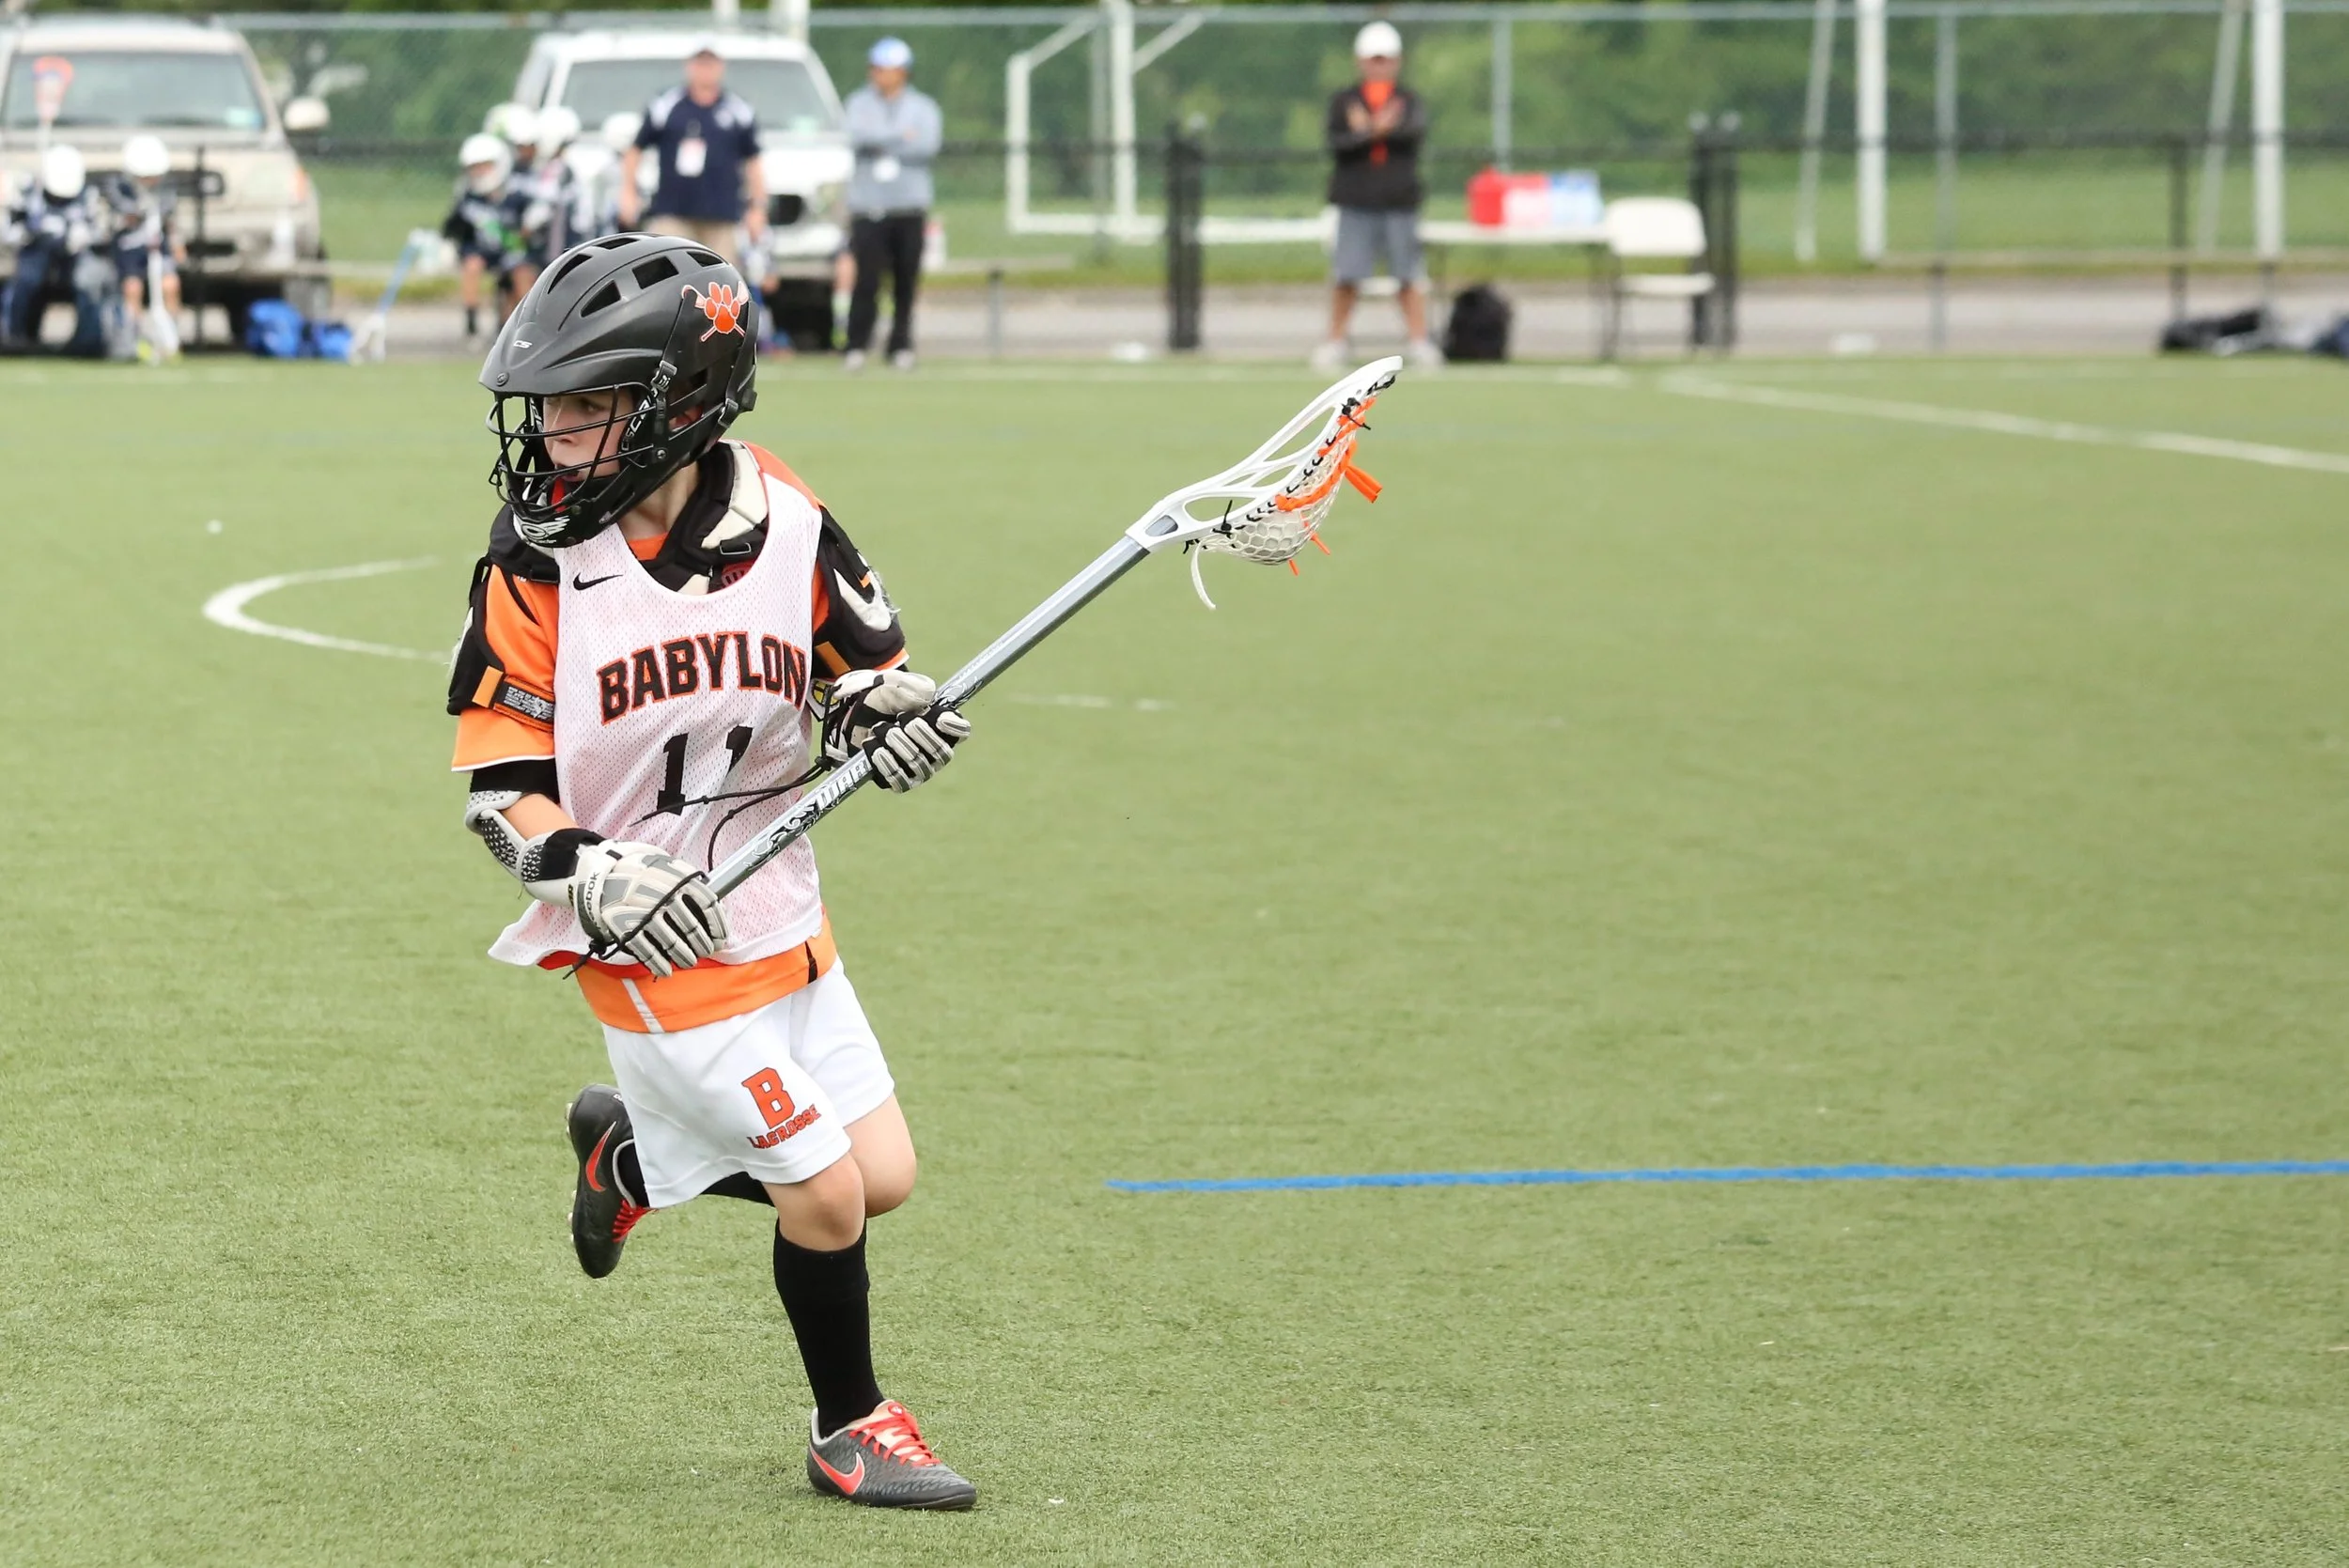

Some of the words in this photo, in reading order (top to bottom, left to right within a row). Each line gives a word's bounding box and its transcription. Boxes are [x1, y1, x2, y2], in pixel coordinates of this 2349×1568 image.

[596, 630, 807, 726] BABYLON
[657, 724, 754, 816] 11
[740, 1066, 796, 1129] B
[746, 1103, 822, 1149] LACROSSE
